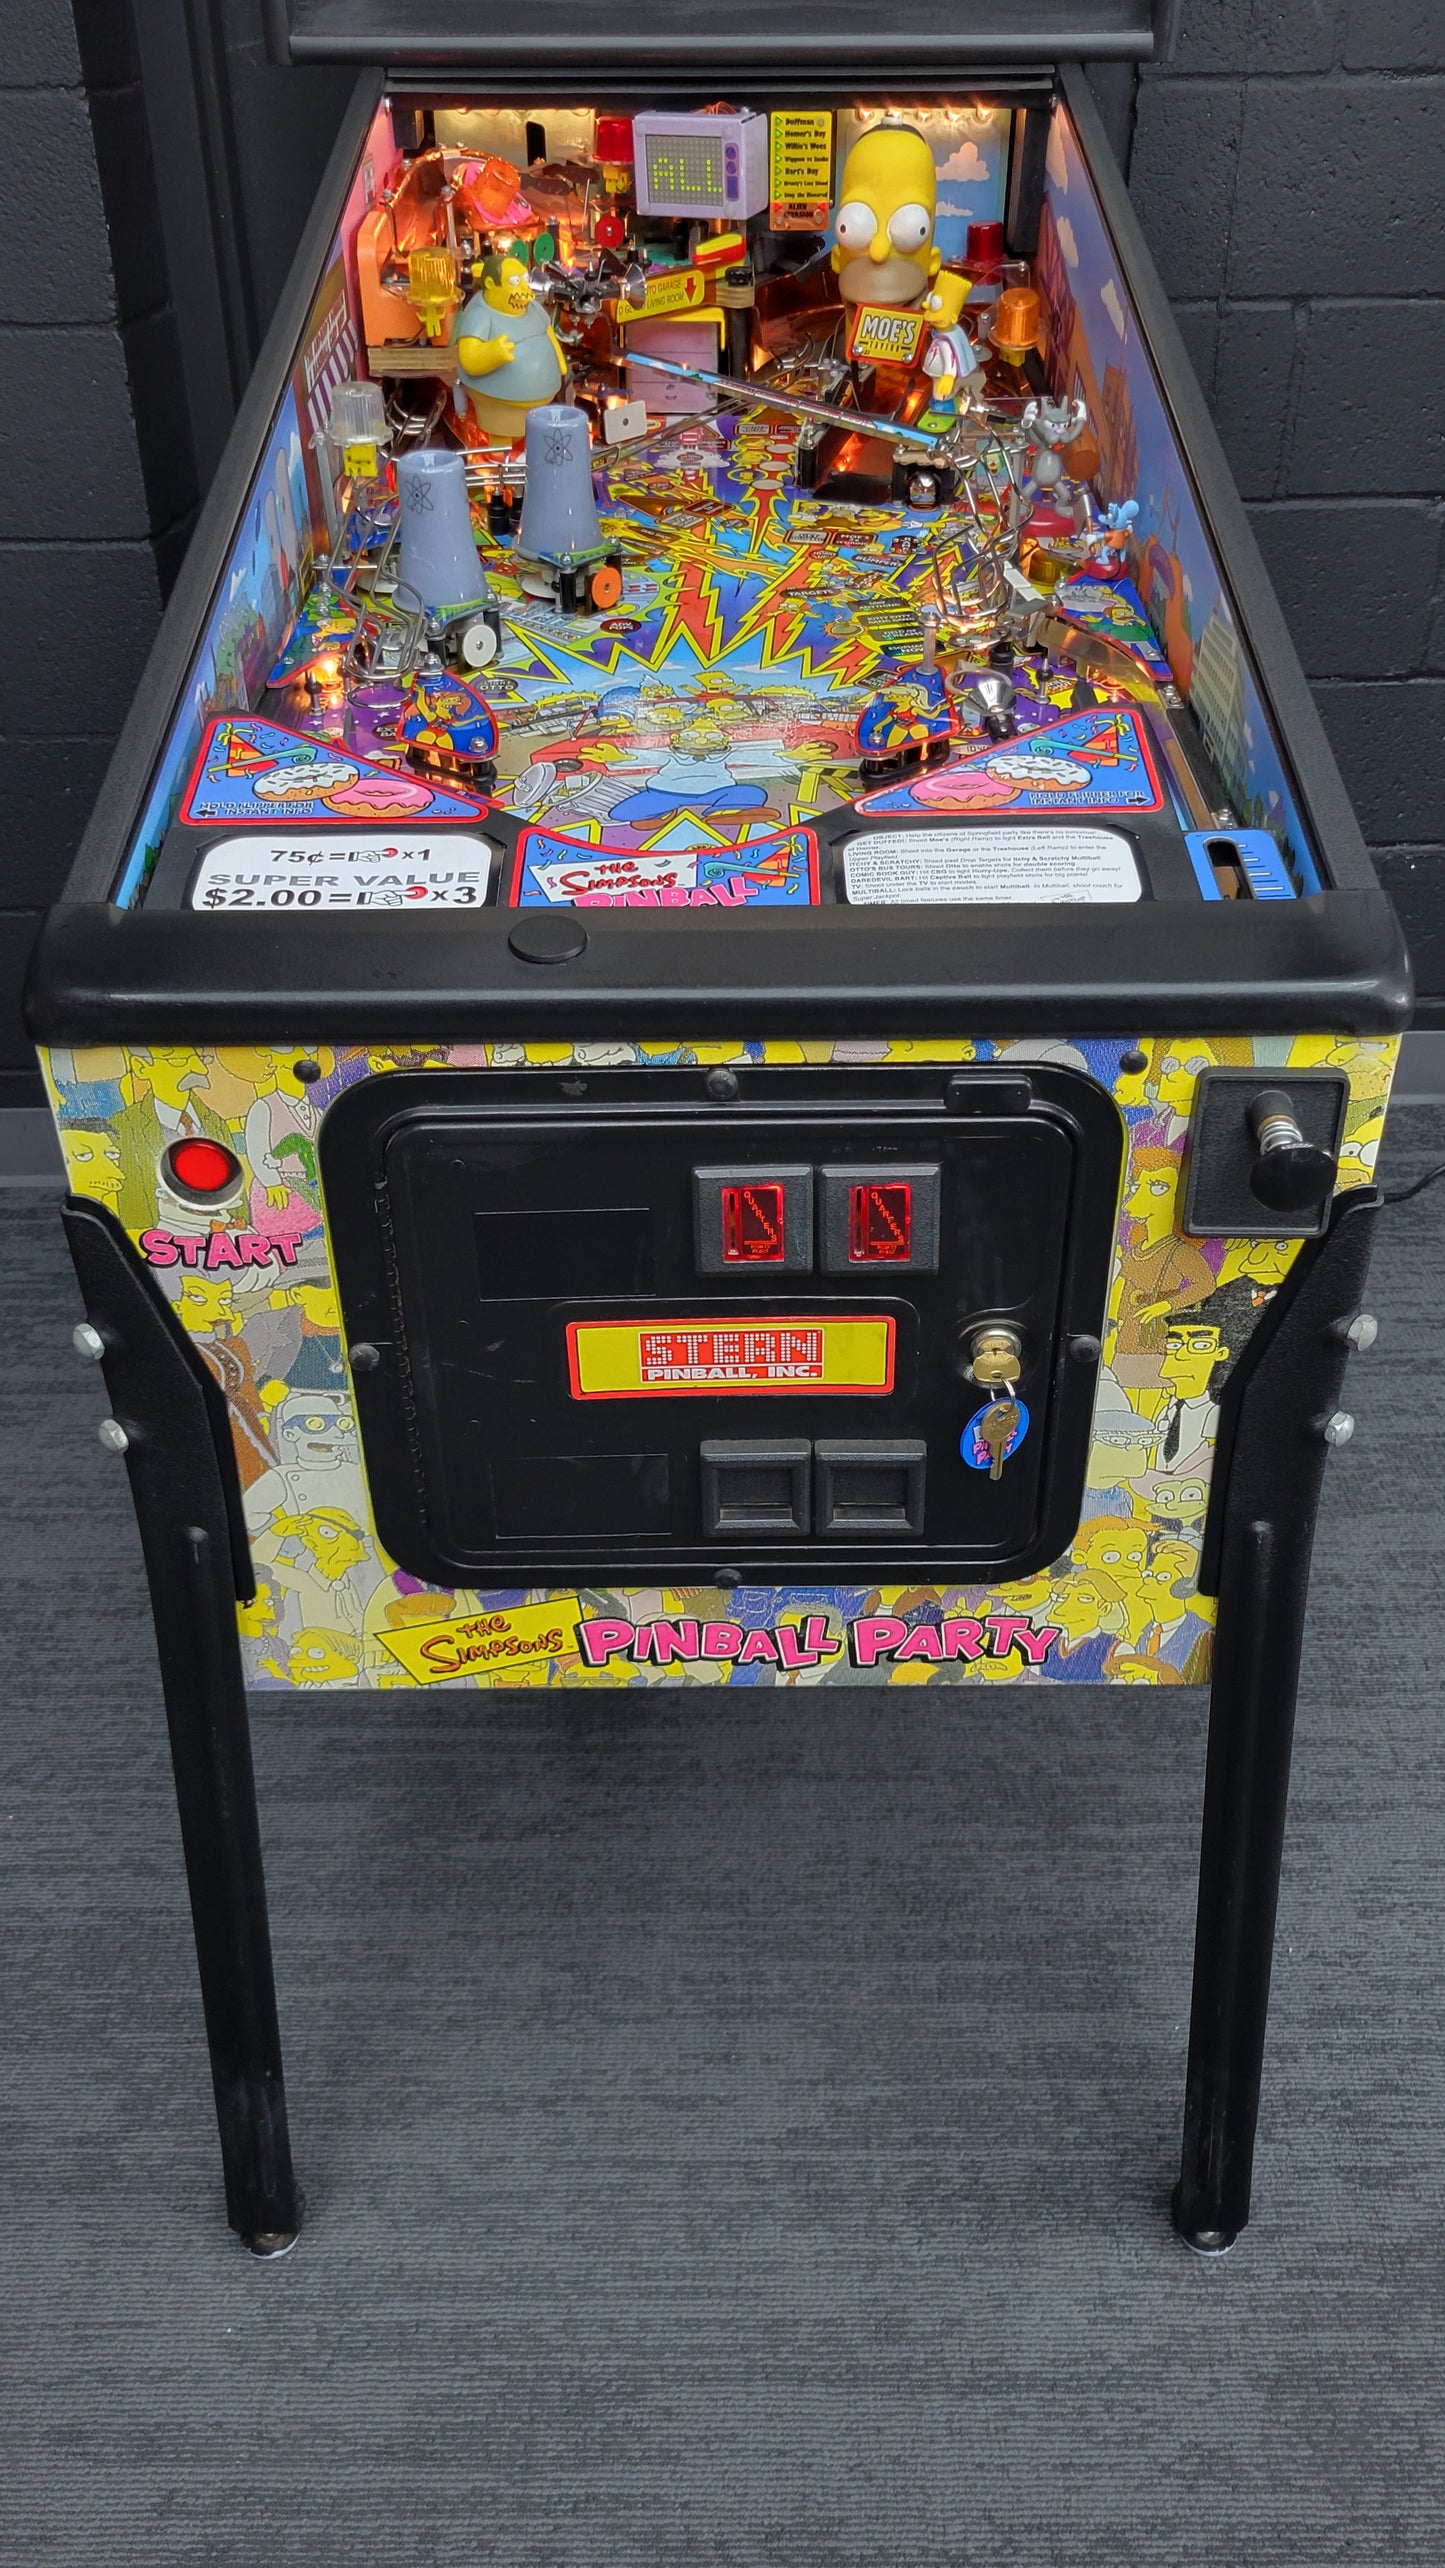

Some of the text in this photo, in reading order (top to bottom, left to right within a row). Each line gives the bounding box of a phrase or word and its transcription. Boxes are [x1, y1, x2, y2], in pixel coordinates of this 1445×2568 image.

[814, 130, 826, 138] Day
[652, 157, 723, 193] ALL
[807, 168, 819, 176] Day
[657, 280, 681, 292] GARAGE
[666, 292, 684, 304] ROOM
[861, 314, 917, 345] MOE'S
[239, 801, 286, 809] FLIPPER
[207, 871, 480, 887] SUPER VALUE
[572, 876, 759, 907] PINBALL
[744, 1191, 777, 1242] QUARTERS
[871, 1192, 904, 1242] QUARTERS
[140, 1228, 303, 1271] START
[645, 1332, 818, 1365] STERN
[647, 1365, 818, 1380] PINBALL, INC.
[577, 1614, 1062, 1670] PINBALL PARTY
